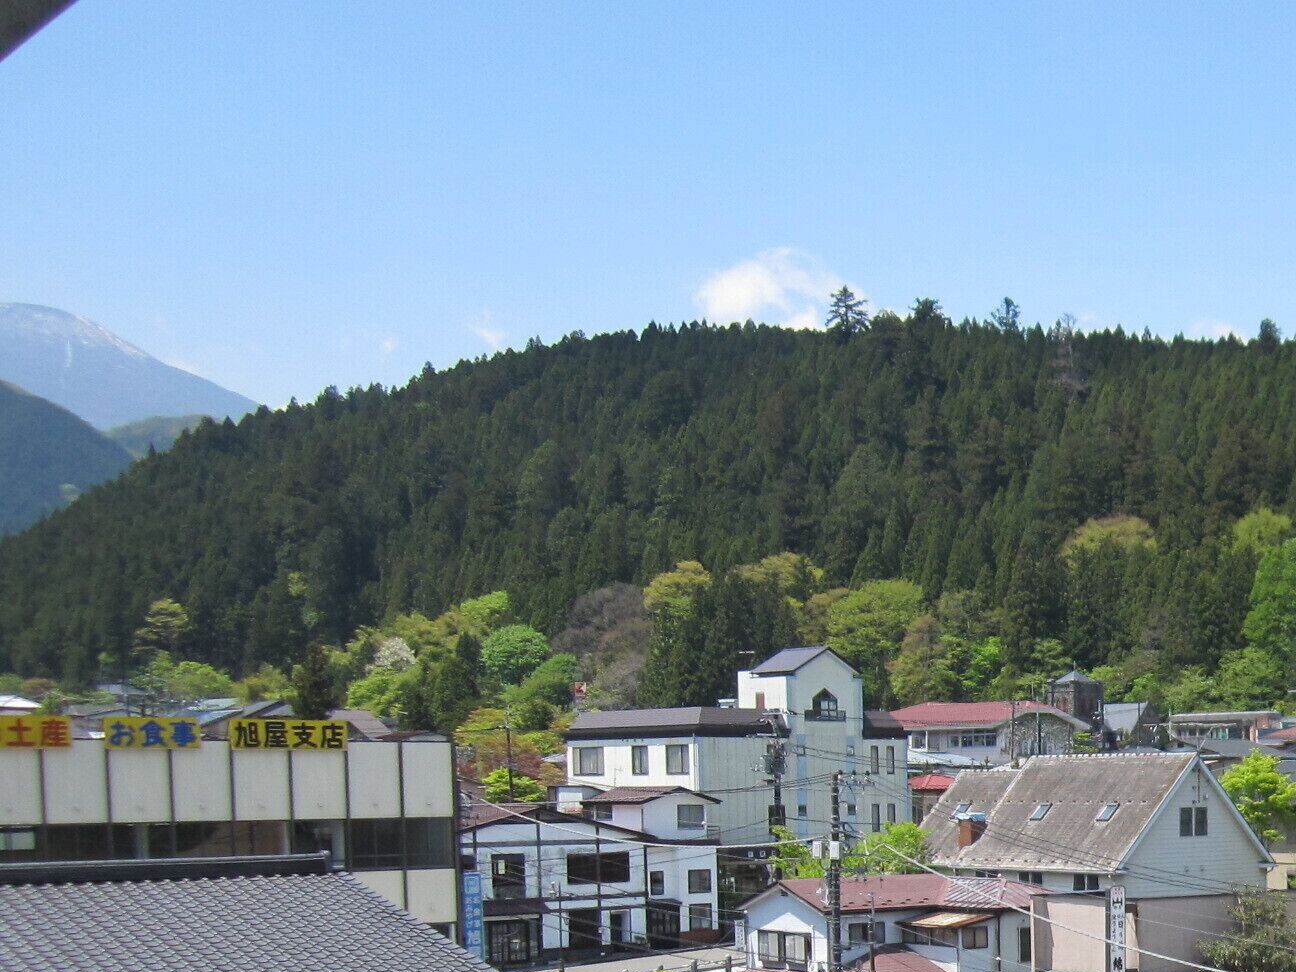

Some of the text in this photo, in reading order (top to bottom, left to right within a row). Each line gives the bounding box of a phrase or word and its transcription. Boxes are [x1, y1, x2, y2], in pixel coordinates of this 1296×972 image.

[0, 719, 70, 747] 土産
[110, 721, 197, 746] お食事
[235, 722, 344, 749] 旭屋支店
